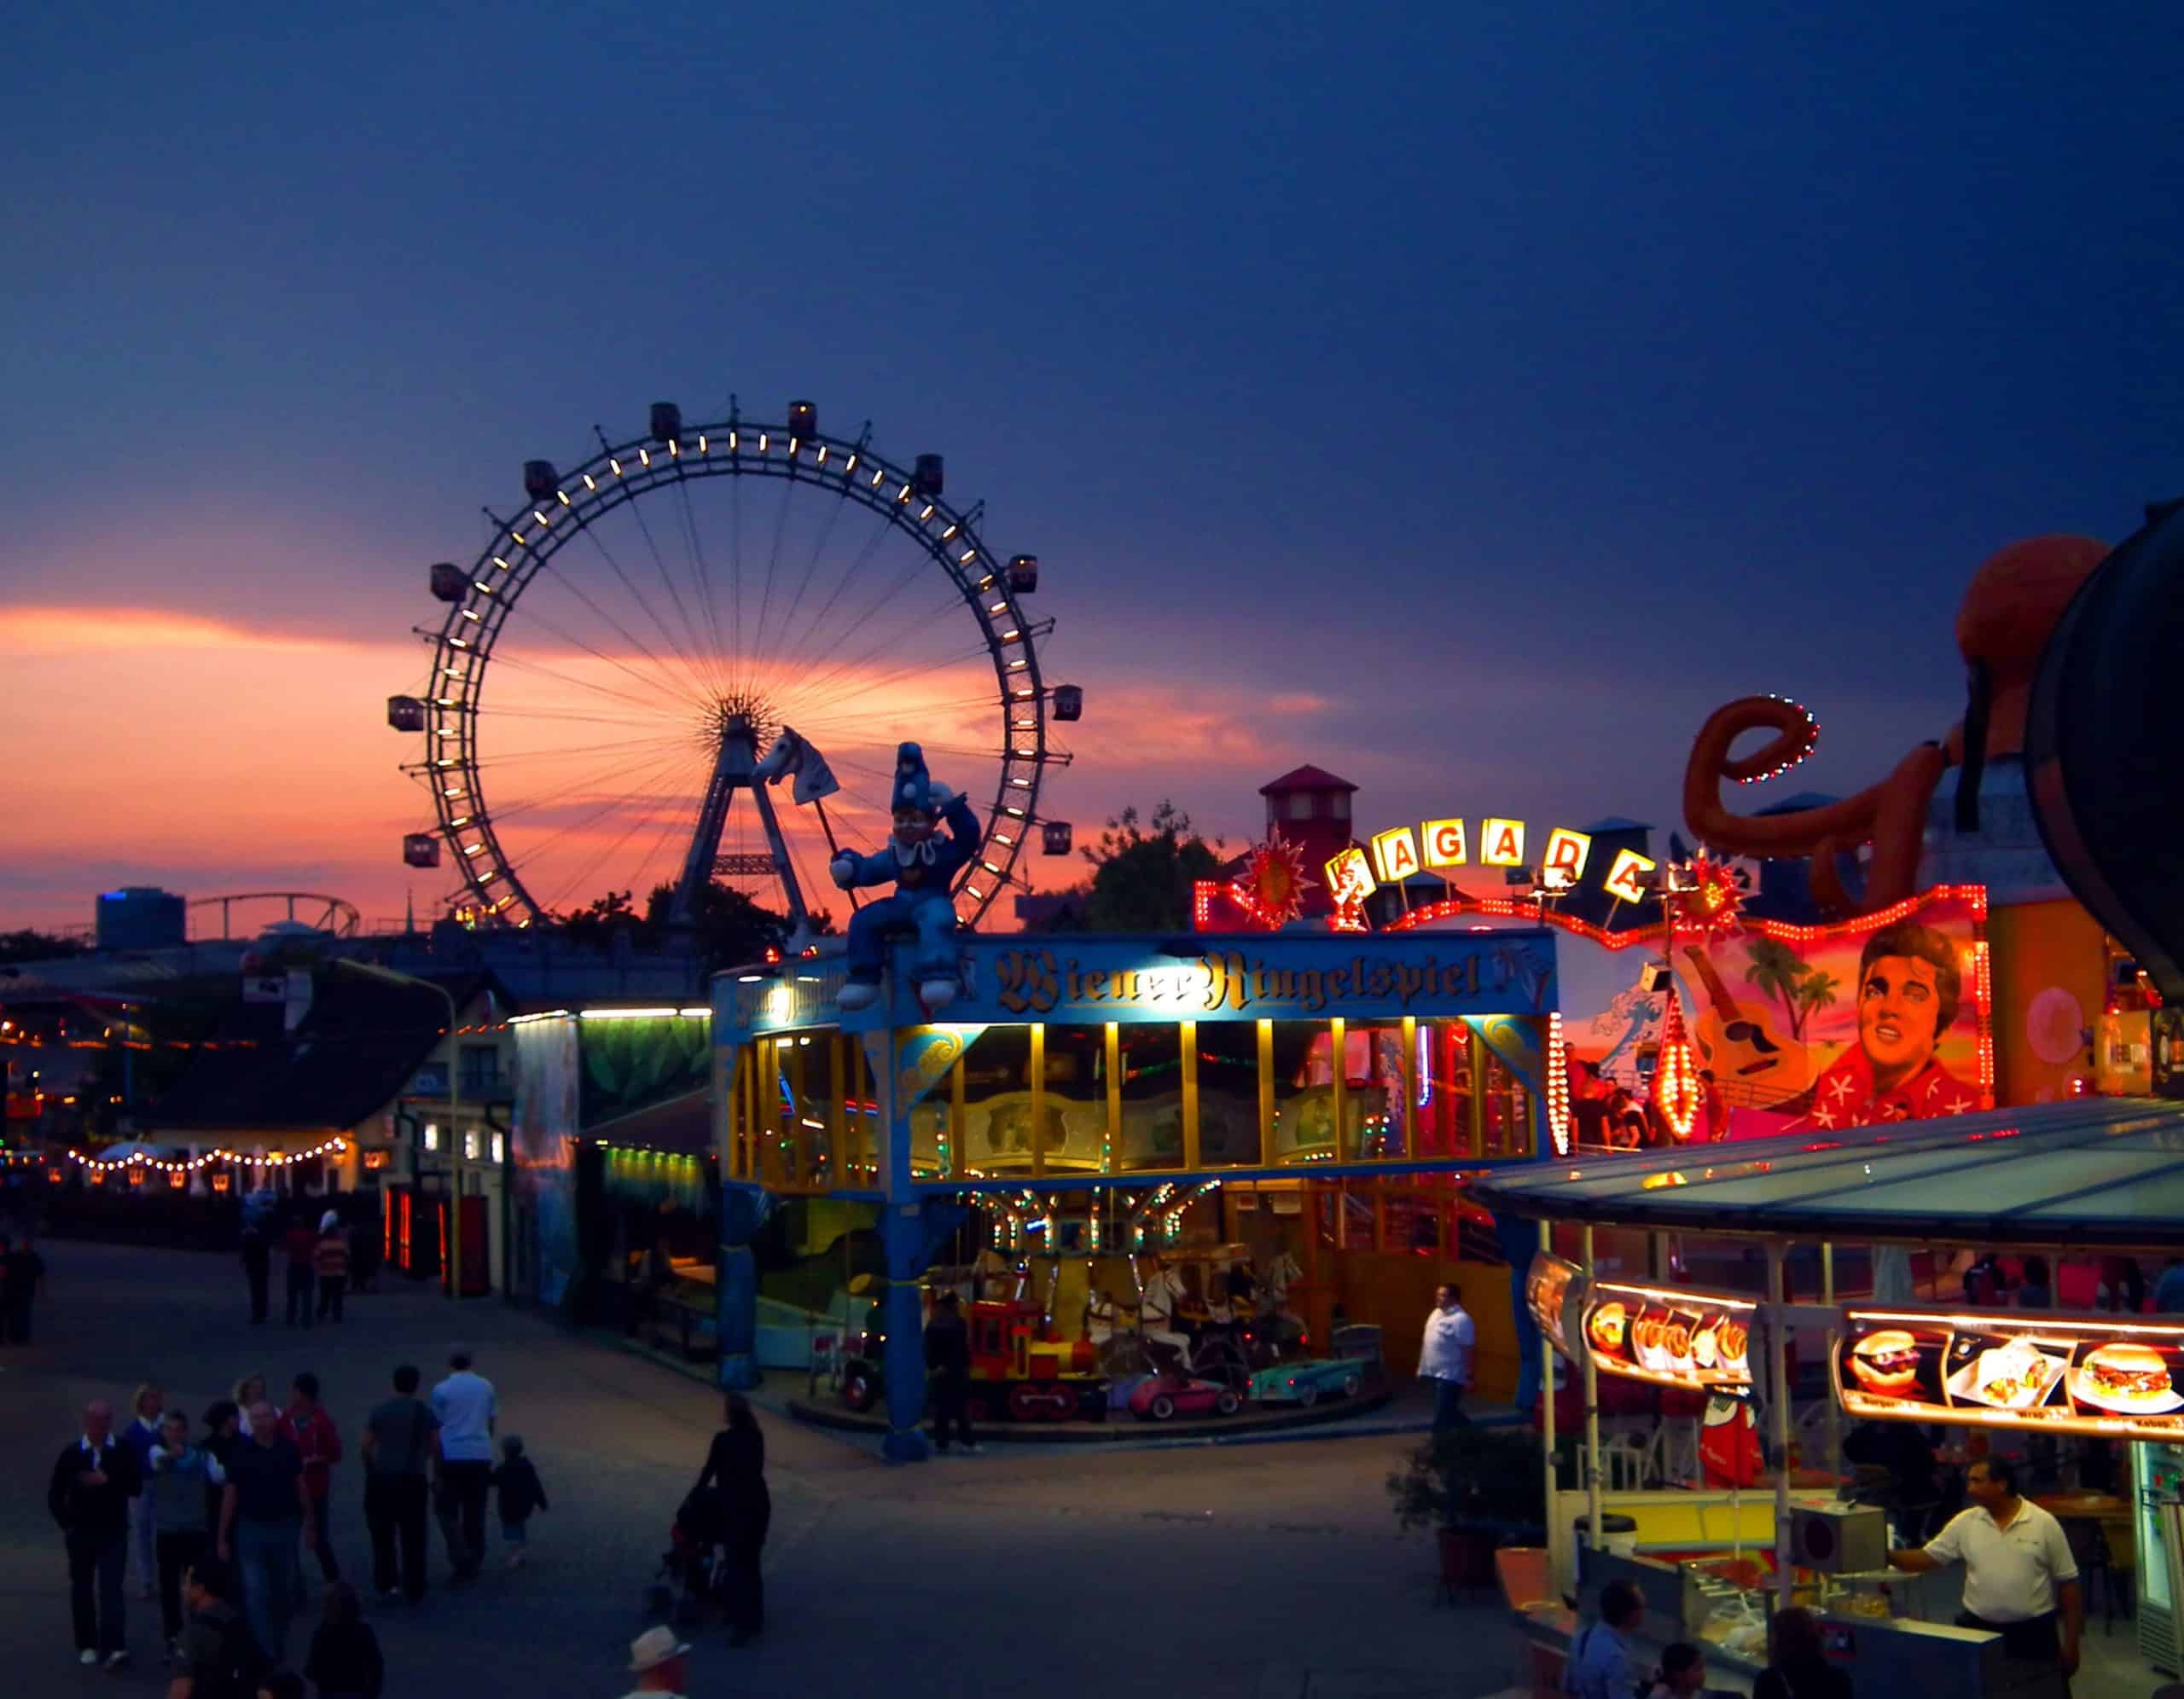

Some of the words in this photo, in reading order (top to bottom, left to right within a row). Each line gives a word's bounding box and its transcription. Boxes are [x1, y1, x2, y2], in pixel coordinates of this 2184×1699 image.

[1332, 826, 1641, 896] AGADA
[996, 949, 1192, 1013] Wiener
[1199, 948, 1481, 1013] Ringelspiel
